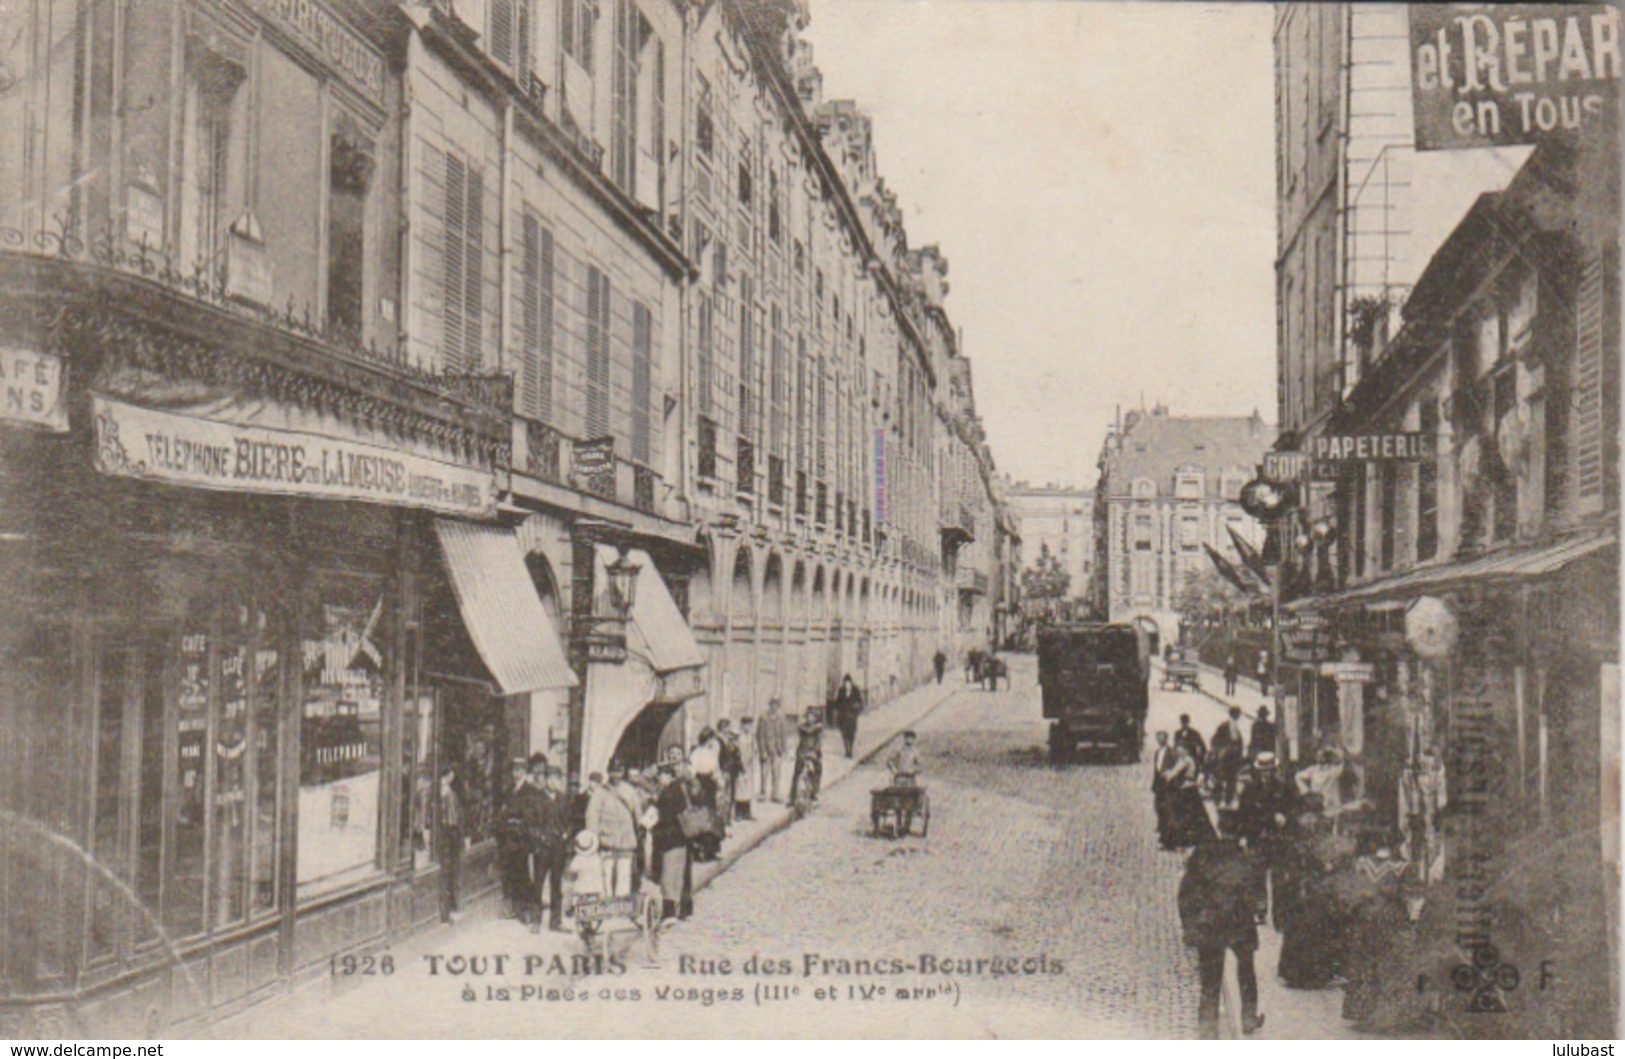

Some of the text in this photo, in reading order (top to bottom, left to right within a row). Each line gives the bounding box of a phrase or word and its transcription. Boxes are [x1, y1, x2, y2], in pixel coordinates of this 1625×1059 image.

[1417, 13, 1621, 94] et RÉPAR
[1452, 100, 1500, 135] en
[145, 430, 230, 478] TÉLÉPHONE
[1317, 433, 1428, 460] PAPETERIE
